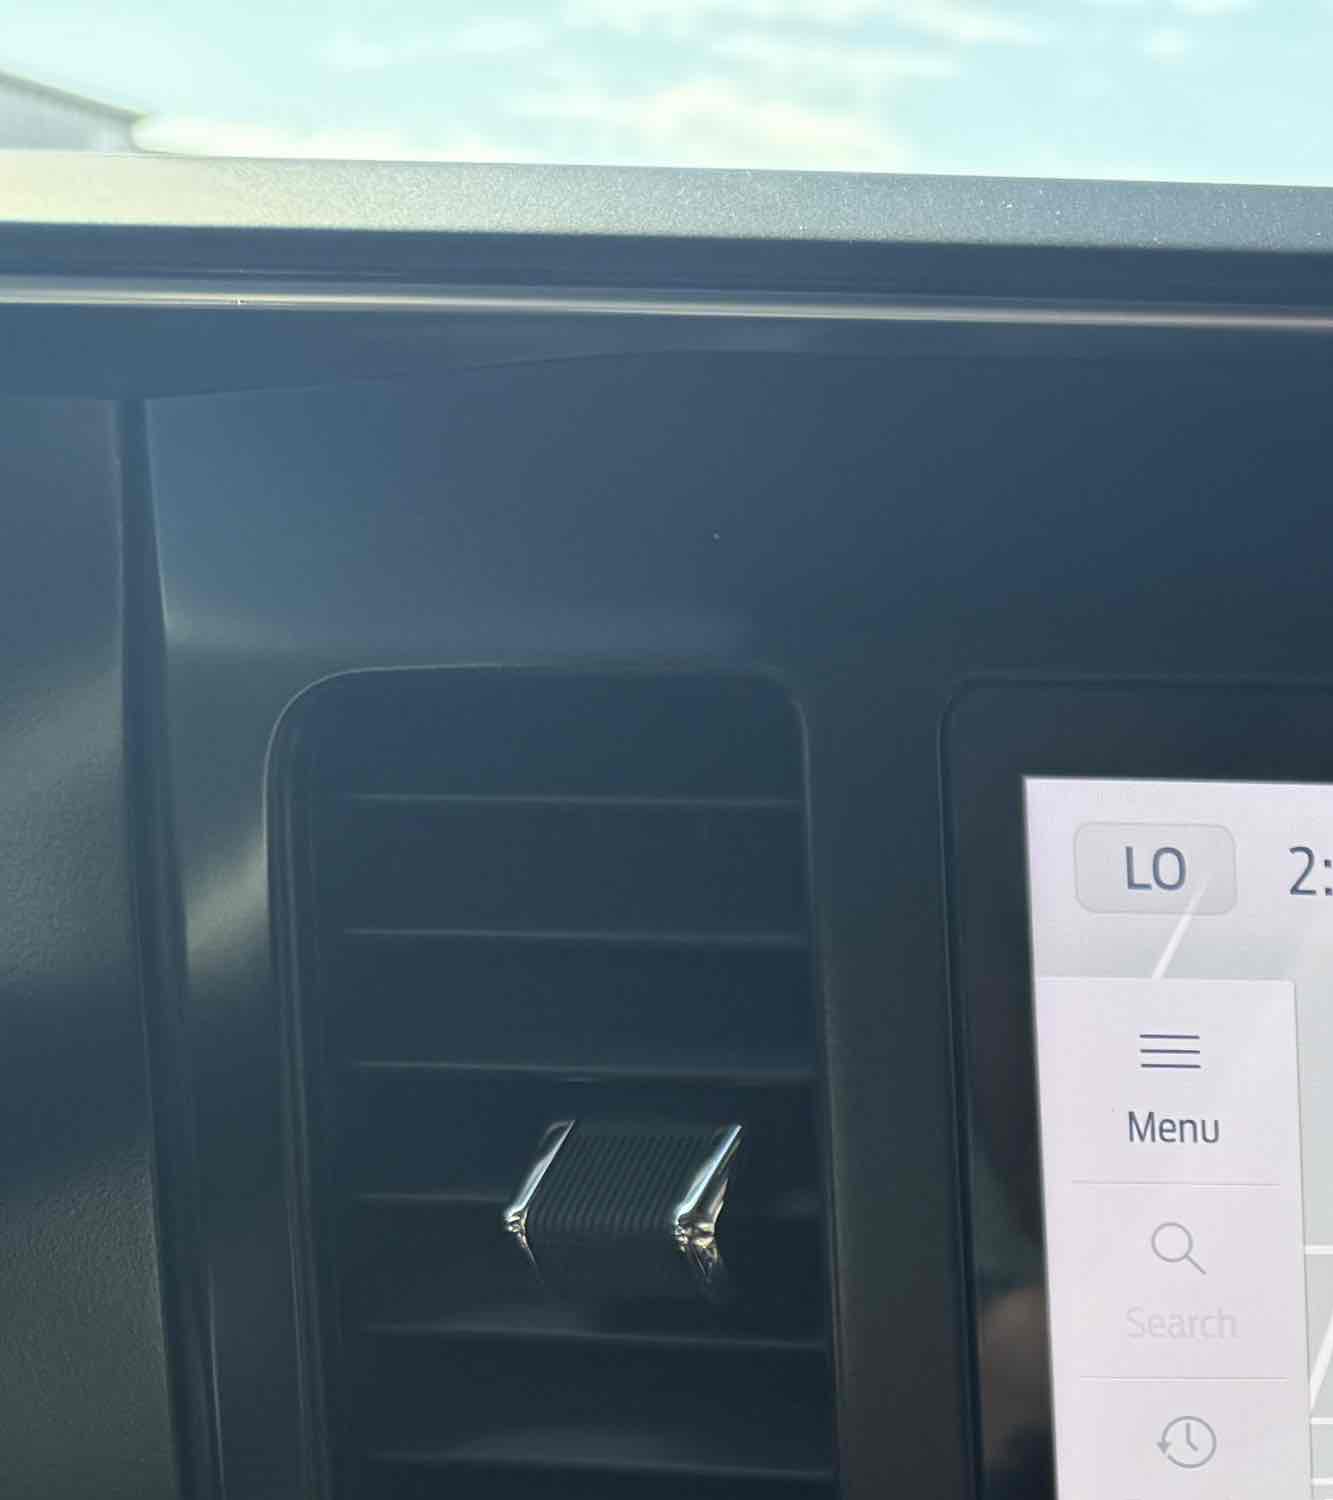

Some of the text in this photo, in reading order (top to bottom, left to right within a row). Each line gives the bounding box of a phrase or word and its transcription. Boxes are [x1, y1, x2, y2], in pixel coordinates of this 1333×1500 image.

[1125, 845, 1188, 892] LO
[1126, 1109, 1221, 1144] Menu
[1126, 1306, 1239, 1340] Search
